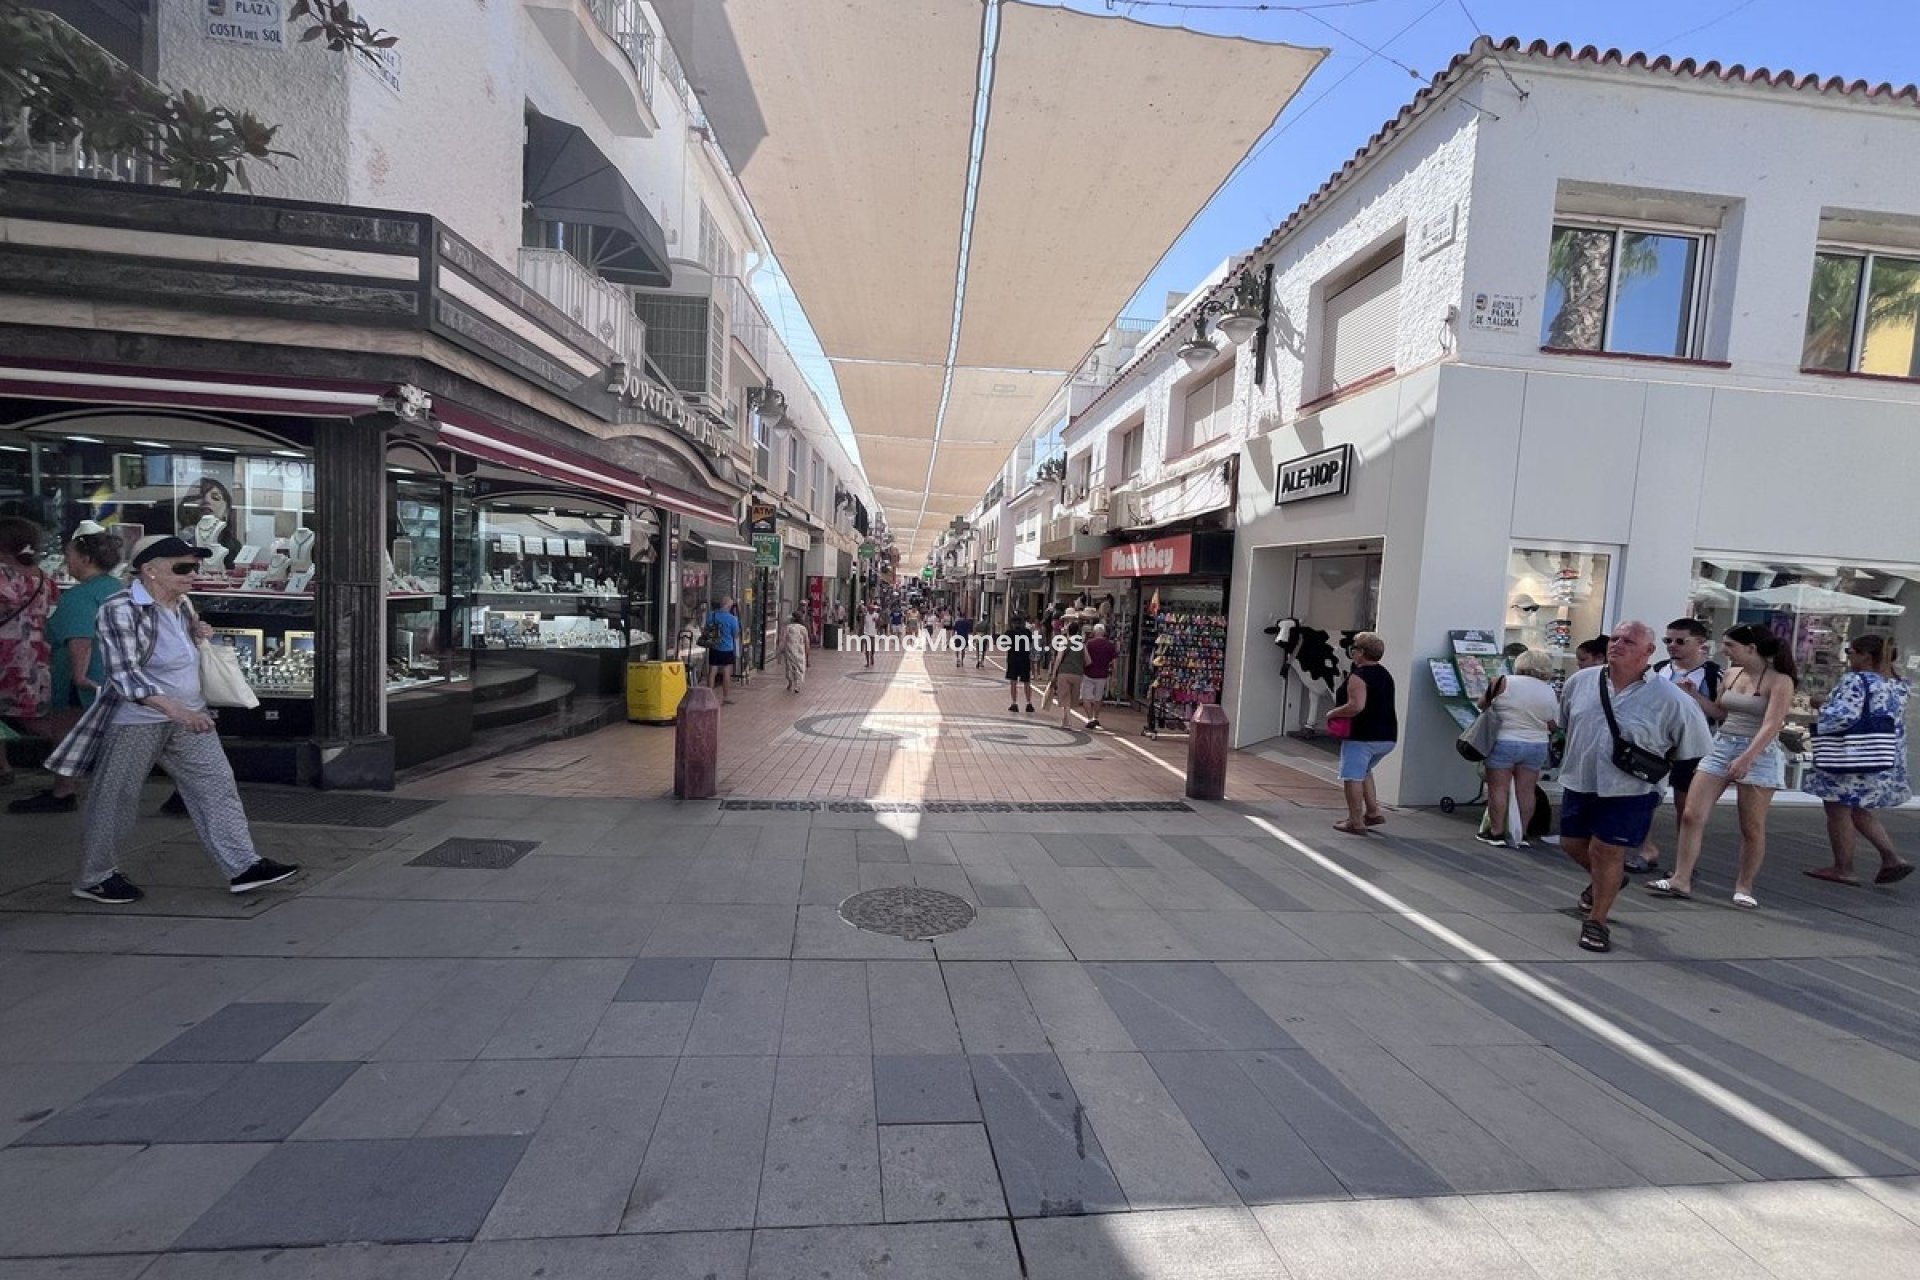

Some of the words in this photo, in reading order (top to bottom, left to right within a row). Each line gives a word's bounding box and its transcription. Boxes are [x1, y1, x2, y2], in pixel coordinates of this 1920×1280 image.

[235, 1, 271, 16] PLAZA
[209, 23, 243, 39] COSTA
[262, 28, 282, 43] SOL
[1490, 308, 1516, 318] PALMA
[1476, 314, 1484, 324] DE
[1487, 316, 1519, 328] MALLORCA
[1281, 460, 1340, 494] ALE-HOP
[753, 506, 775, 517] ATM
